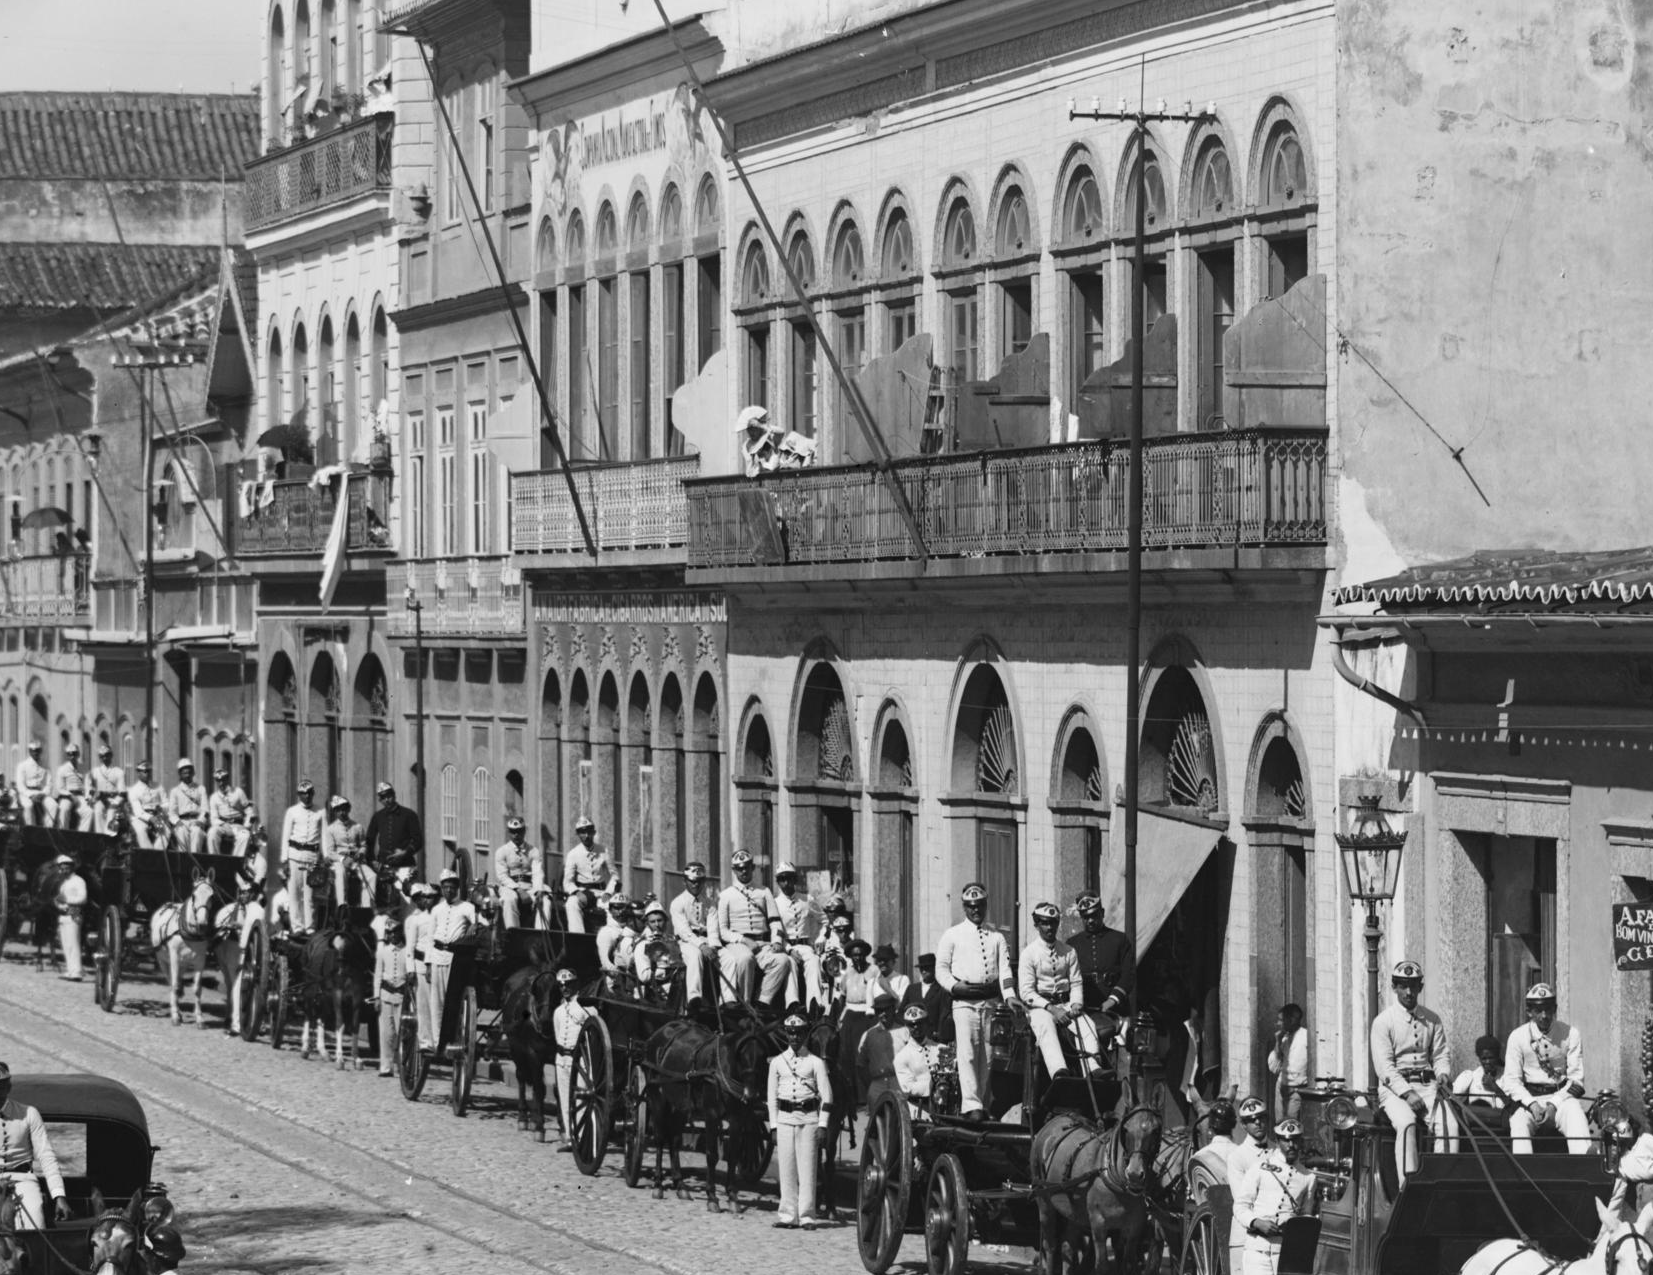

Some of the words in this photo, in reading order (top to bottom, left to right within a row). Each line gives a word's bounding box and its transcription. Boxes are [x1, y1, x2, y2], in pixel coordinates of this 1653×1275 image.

[534, 594, 541, 623] A
[541, 594, 568, 623] MAIOR
[568, 594, 605, 623] FABRICA
[612, 593, 654, 623] CIGARROS
[661, 593, 702, 623] AMERICA
[710, 592, 728, 622] SUL
[1618, 906, 1636, 926] A
[1615, 924, 1636, 942] BOM
